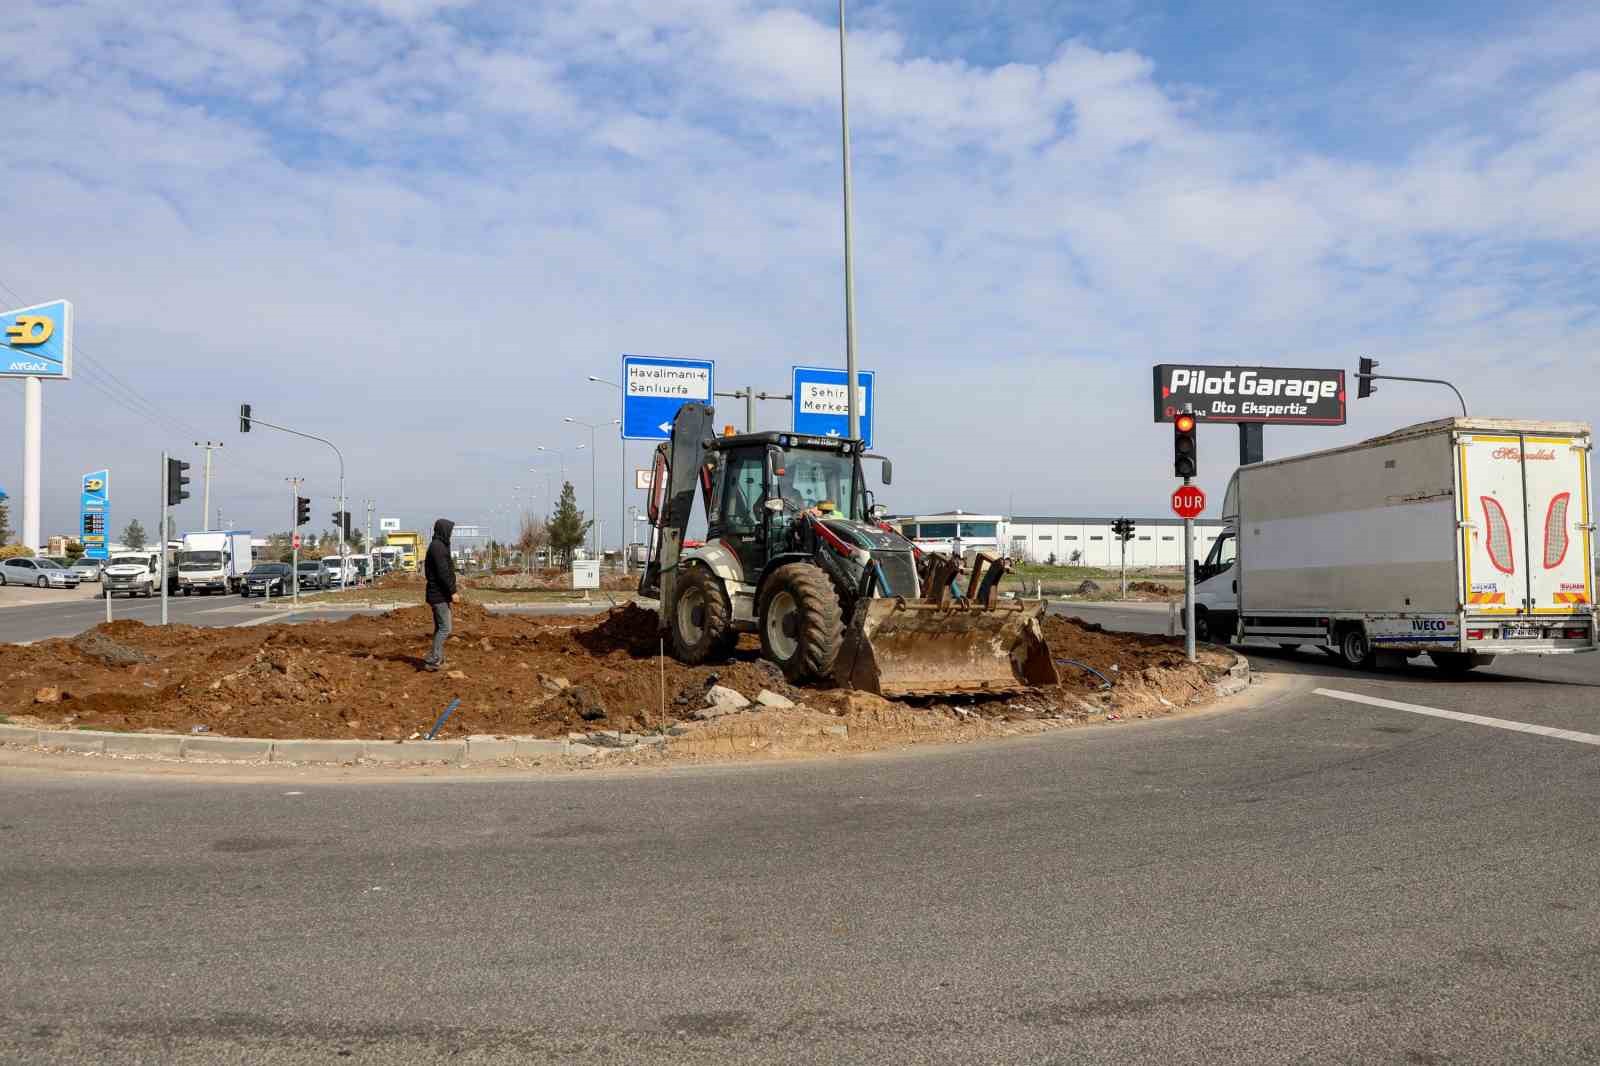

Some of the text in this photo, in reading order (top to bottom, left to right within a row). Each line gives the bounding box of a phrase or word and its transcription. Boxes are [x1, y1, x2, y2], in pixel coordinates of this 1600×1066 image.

[9, 361, 49, 370] AYGAZ
[810, 386, 845, 399] Şehir
[803, 400, 850, 412] Merkez
[1211, 400, 1308, 416] Oto Ekspertiz
[1174, 495, 1202, 508] DUR
[1411, 620, 1446, 631] IVECO
